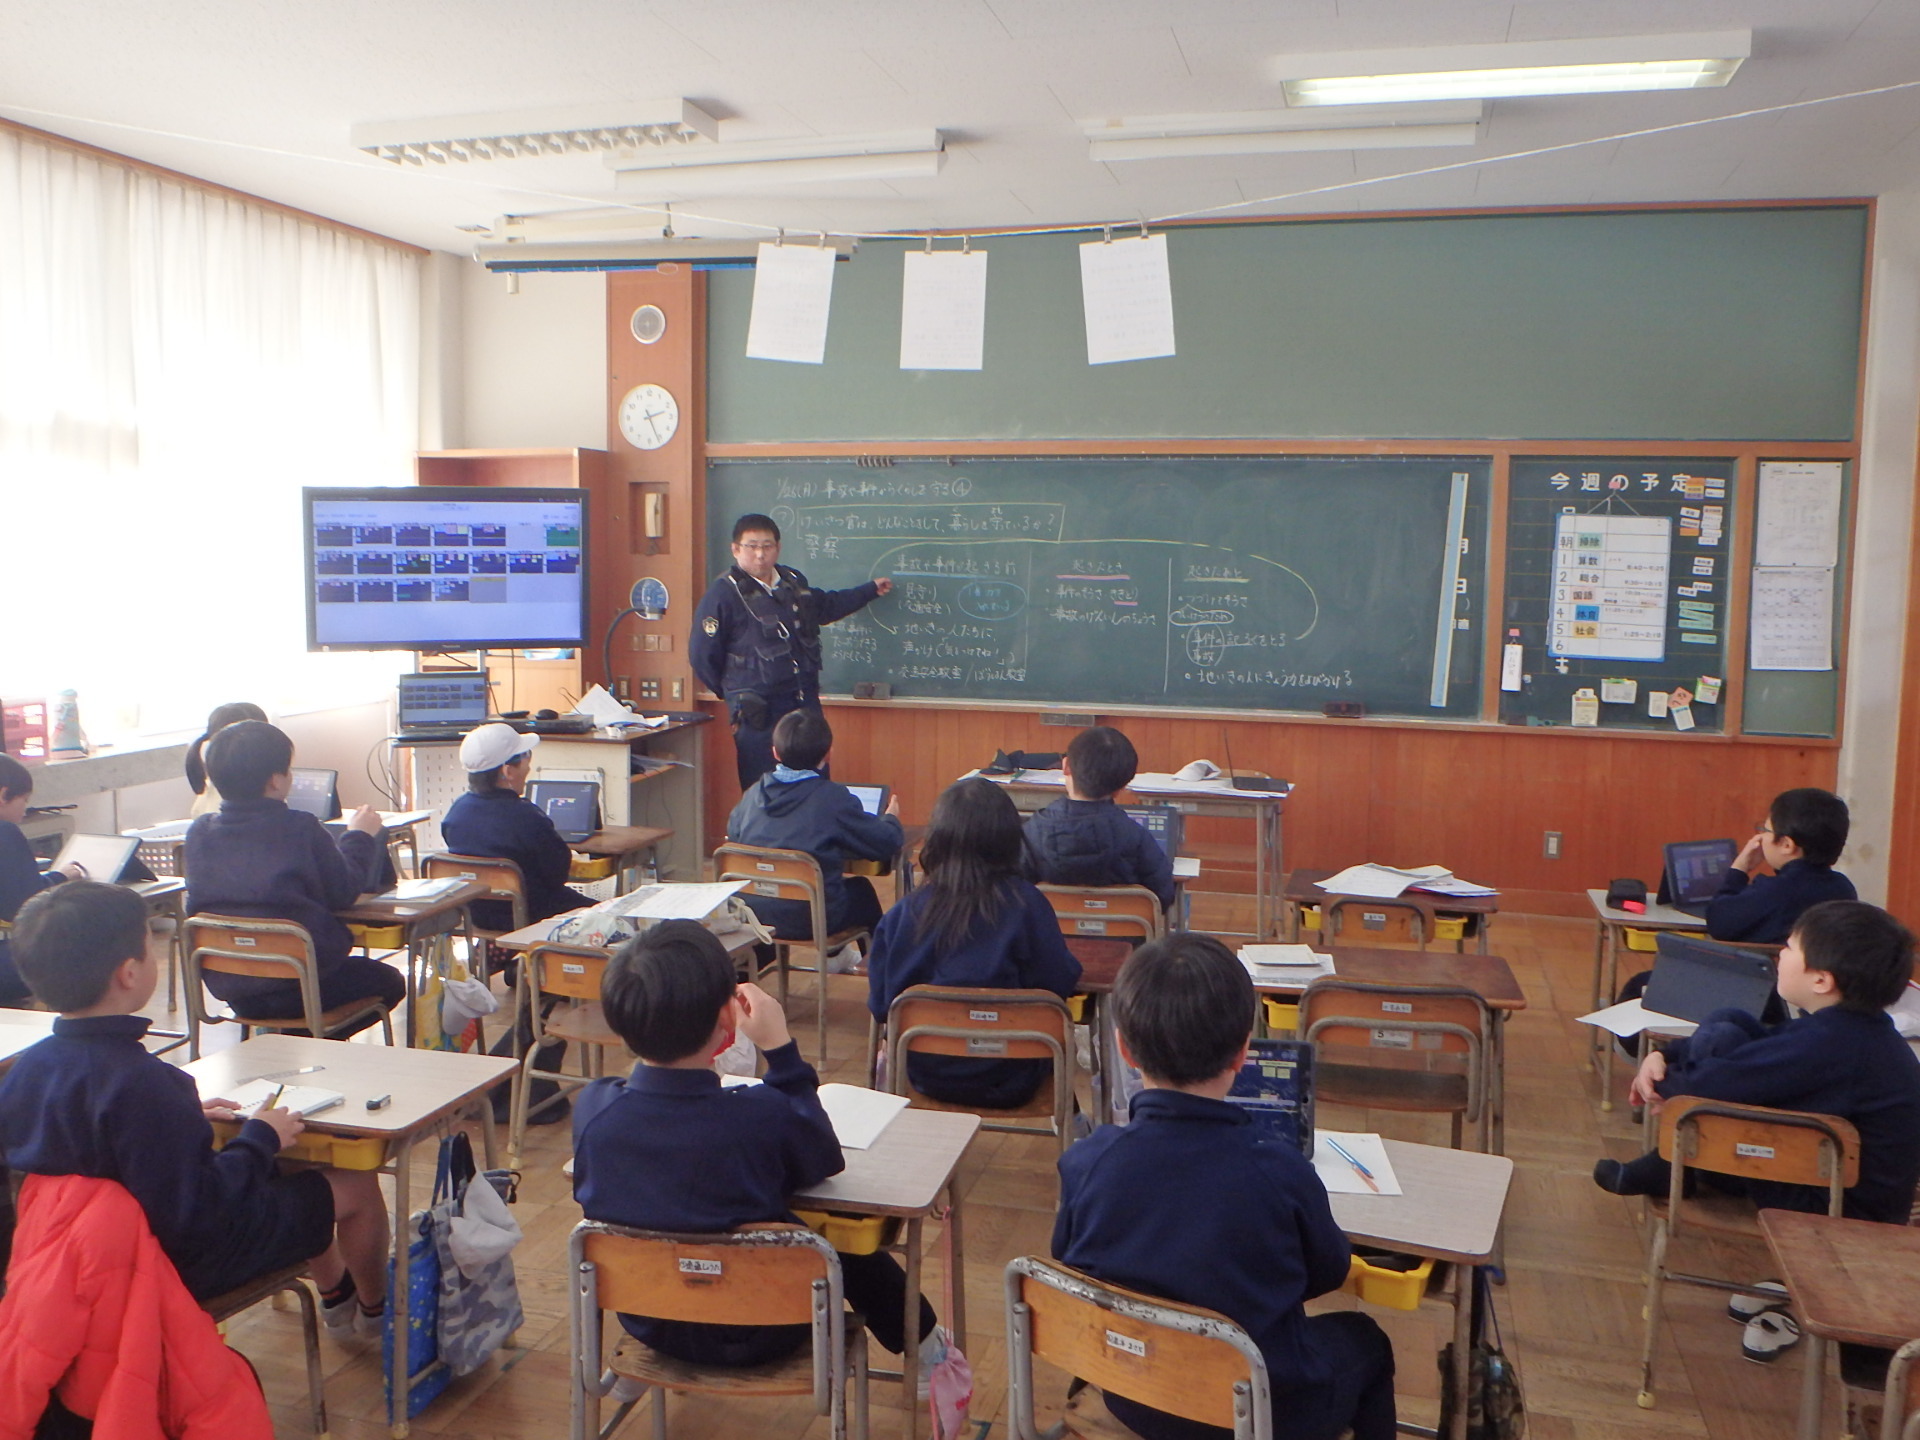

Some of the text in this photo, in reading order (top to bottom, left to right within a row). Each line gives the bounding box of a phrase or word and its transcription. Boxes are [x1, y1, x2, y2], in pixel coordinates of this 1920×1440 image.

[1550, 472, 1692, 493] 今週の予定
[803, 532, 841, 561] 警察
[1560, 536, 1573, 549] 朝
[1578, 556, 1598, 566] 算数
[1559, 571, 1567, 583] 2
[1557, 589, 1565, 601] 3
[1573, 591, 1593, 600] 国語
[1556, 607, 1565, 618] 4
[1556, 624, 1564, 635] 5
[1576, 626, 1596, 636] 社会
[1556, 641, 1564, 651] 6
